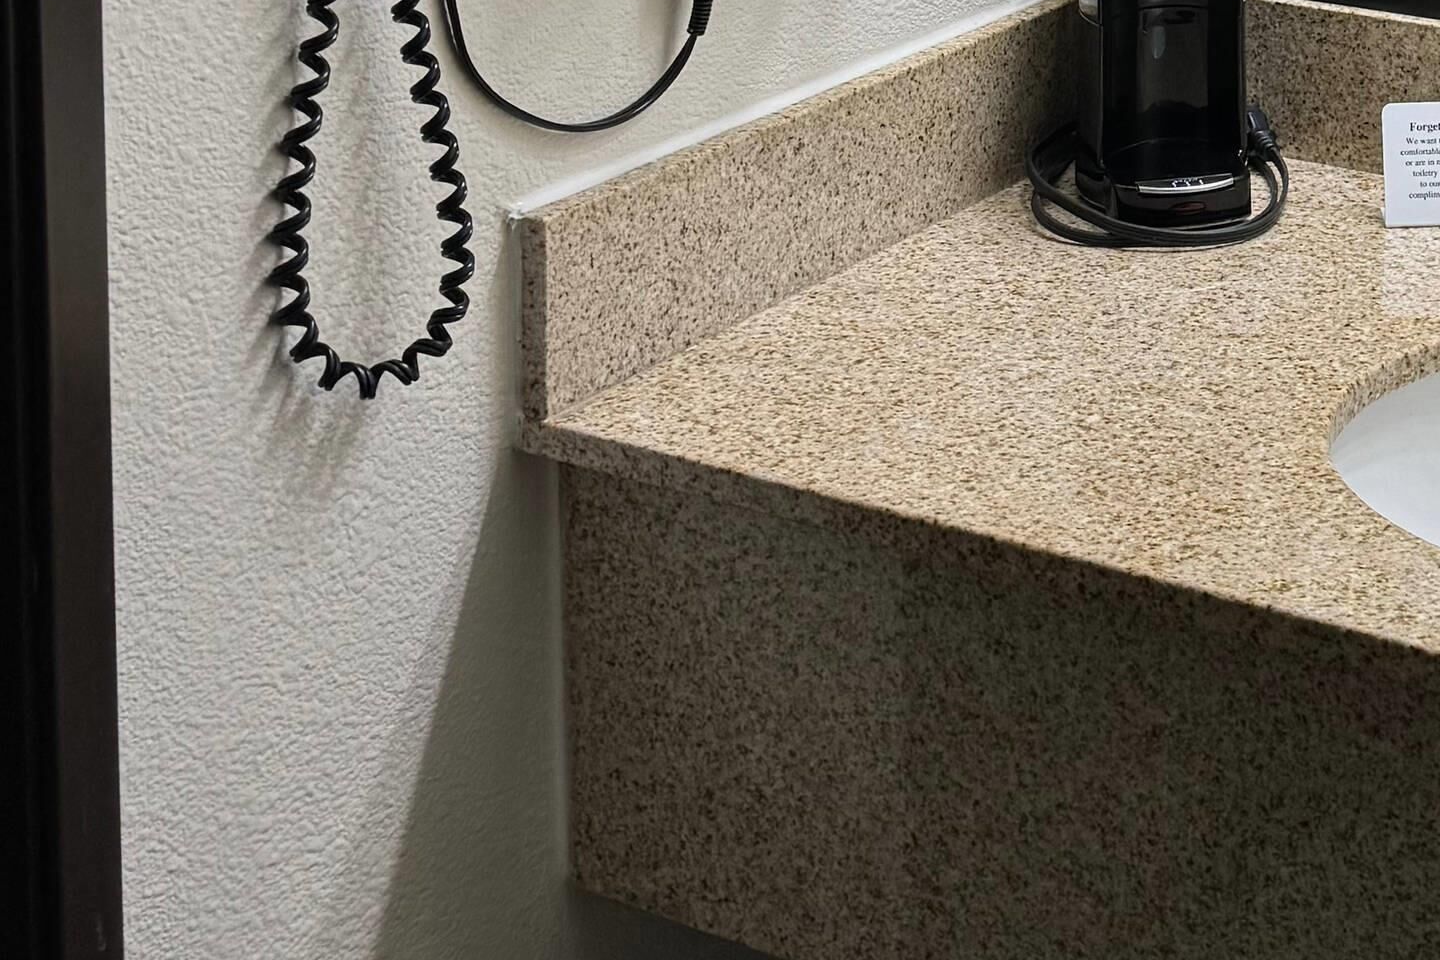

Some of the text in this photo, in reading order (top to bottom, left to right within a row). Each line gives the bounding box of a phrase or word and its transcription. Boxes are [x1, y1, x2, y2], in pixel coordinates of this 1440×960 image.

[1410, 122, 1440, 132] Forget
[1406, 137, 1418, 145] We
[1428, 158, 1435, 166] in
[1412, 168, 1437, 178] toiletry
